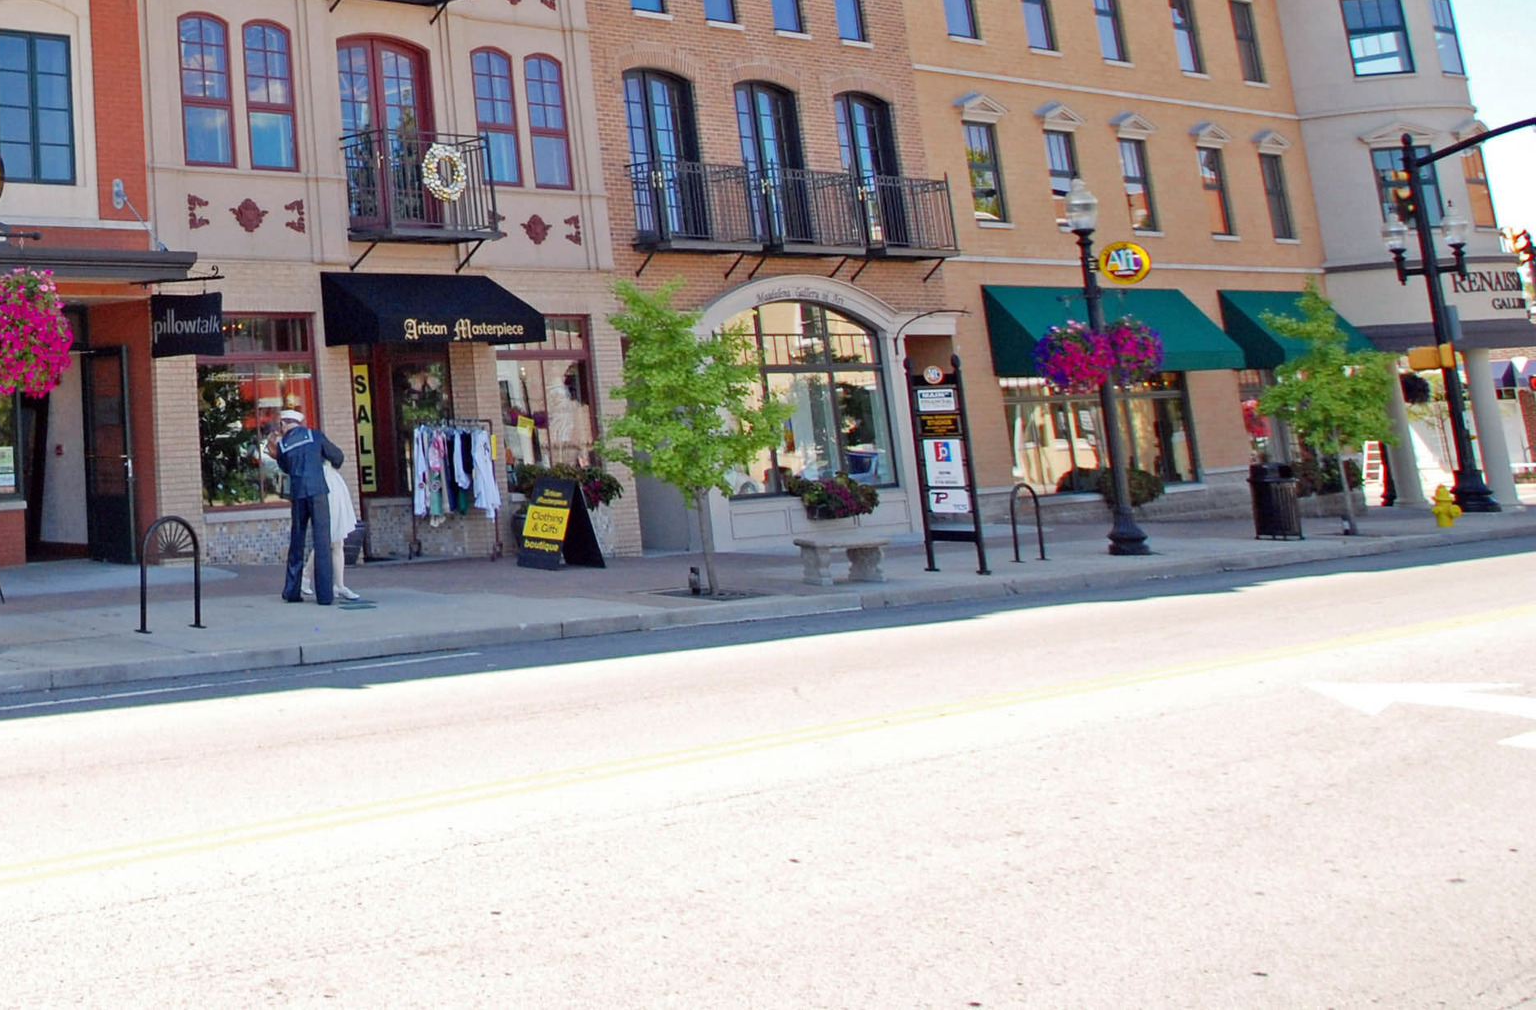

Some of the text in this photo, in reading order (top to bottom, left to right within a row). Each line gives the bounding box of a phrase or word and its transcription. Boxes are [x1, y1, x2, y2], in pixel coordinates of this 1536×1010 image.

[154, 308, 220, 344] pillowtalk
[404, 318, 524, 341] Artisan Masterpiece
[355, 374, 374, 485] SALE
[531, 511, 564, 525] Clothing
[541, 523, 558, 534] Gifts
[524, 538, 560, 553] boutique
